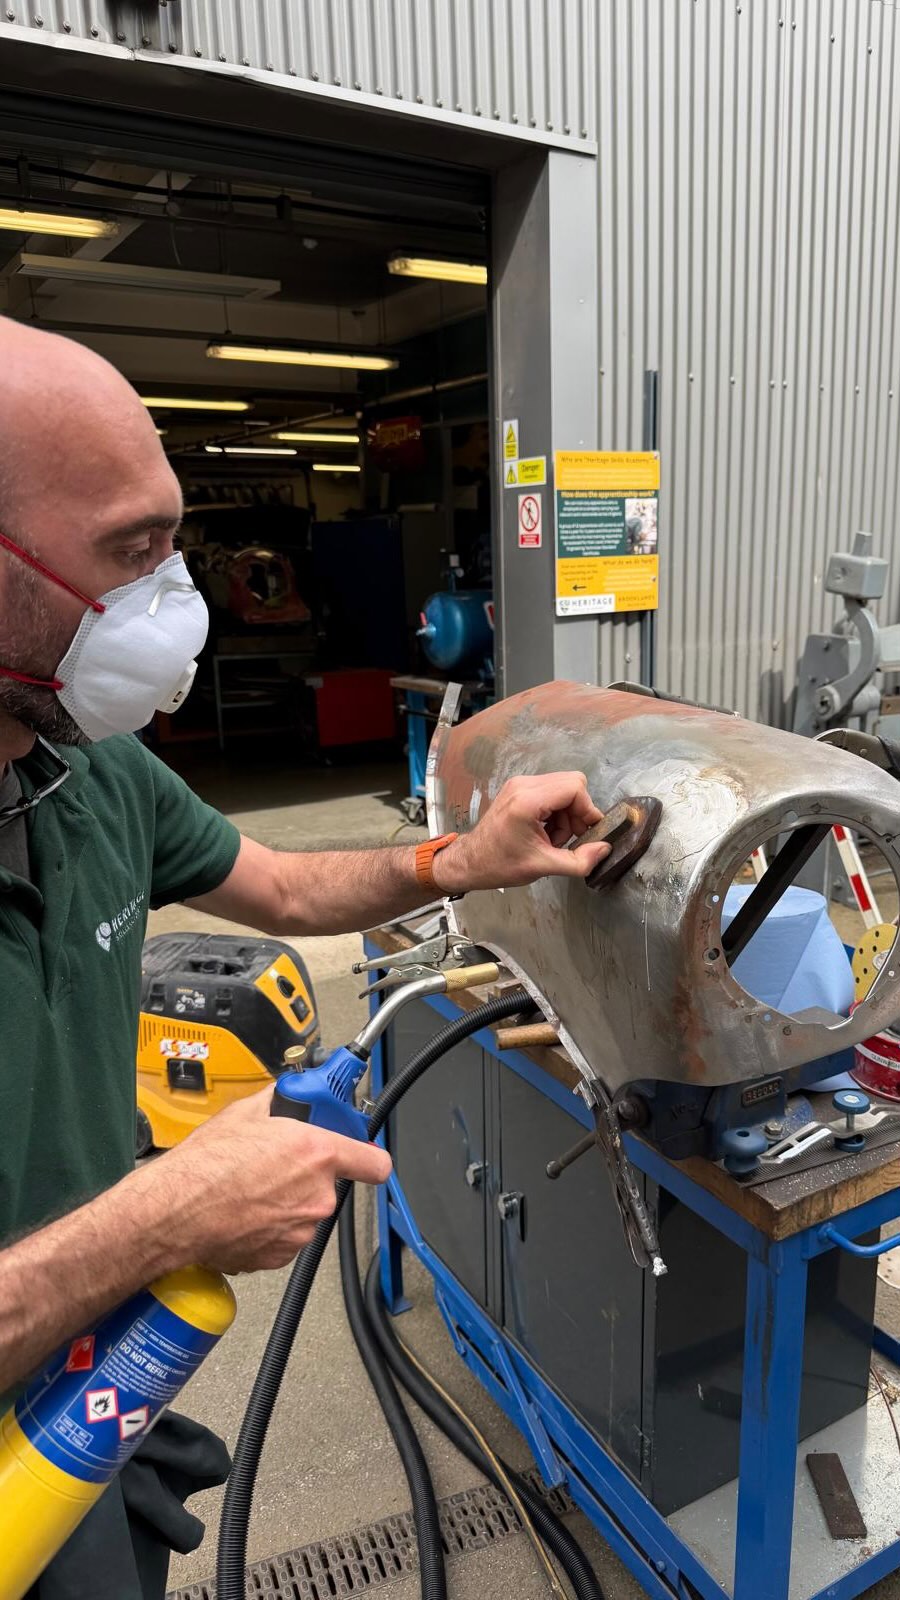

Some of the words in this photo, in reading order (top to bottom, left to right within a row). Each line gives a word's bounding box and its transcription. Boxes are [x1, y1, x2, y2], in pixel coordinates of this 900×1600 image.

[521, 464, 540, 473] Danger
[571, 597, 613, 607] HERITAGE
[120, 1342, 132, 1353] DO
[130, 1352, 147, 1366] NOT
[145, 1363, 168, 1379] REFILL
